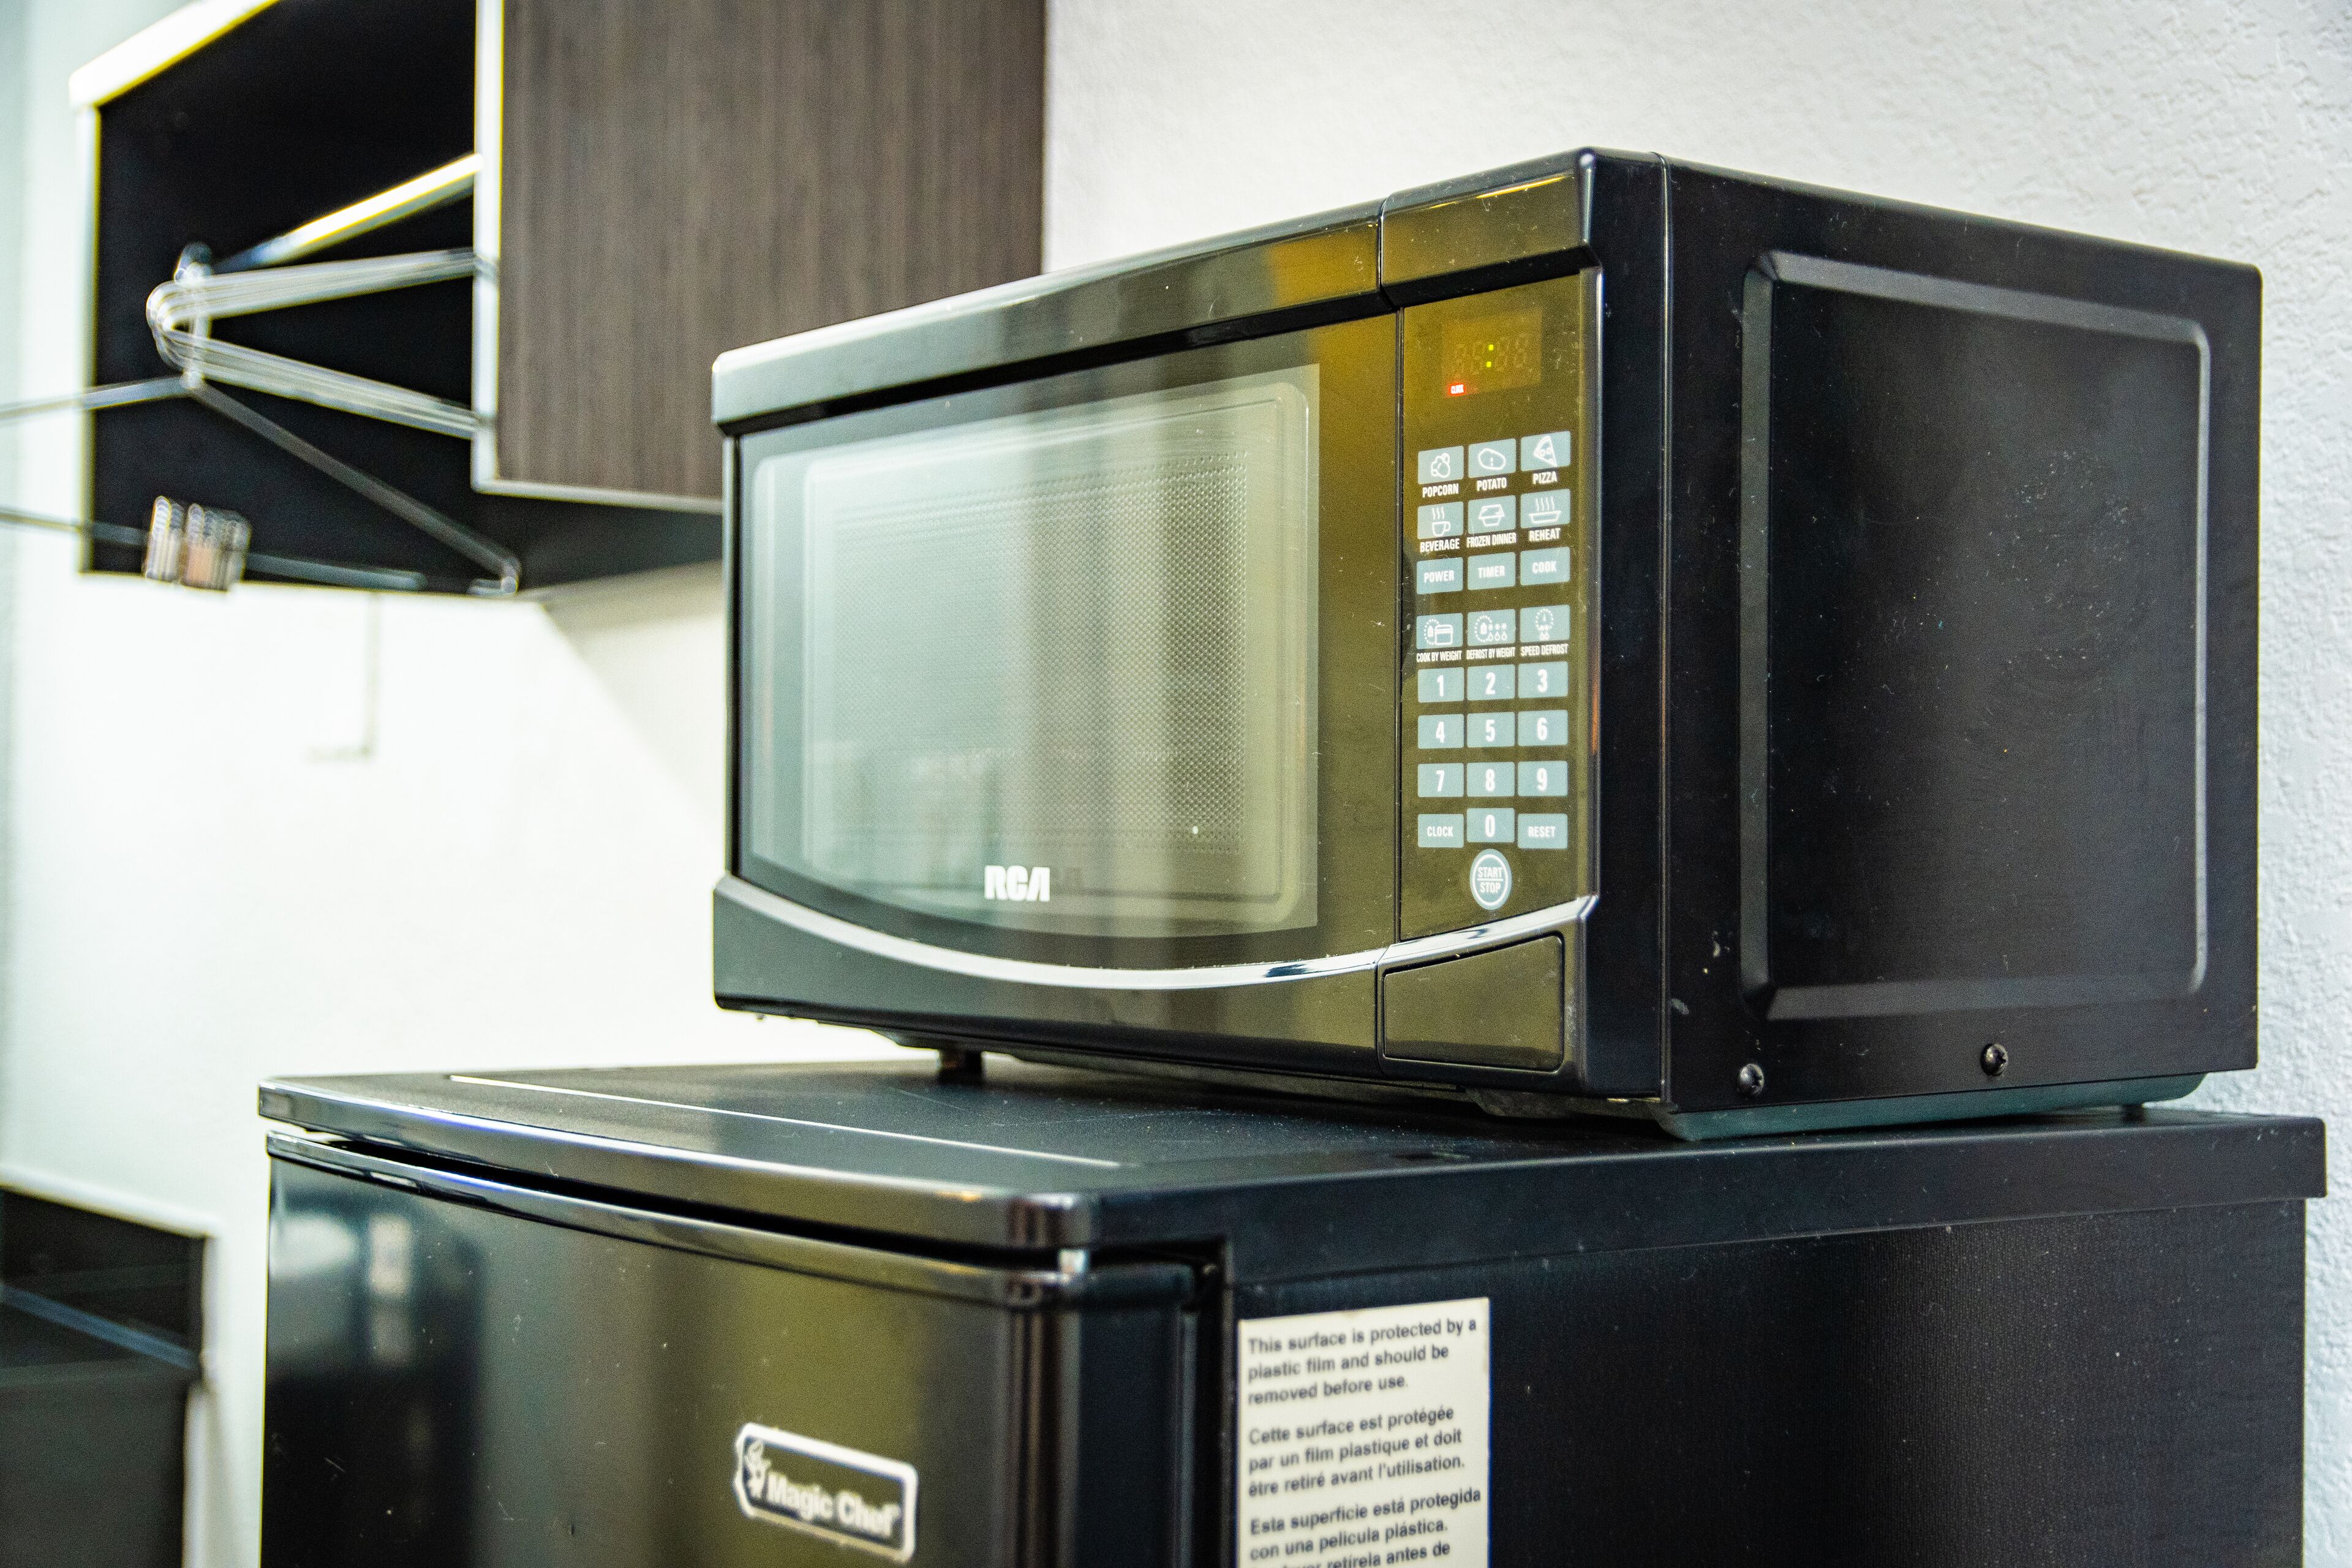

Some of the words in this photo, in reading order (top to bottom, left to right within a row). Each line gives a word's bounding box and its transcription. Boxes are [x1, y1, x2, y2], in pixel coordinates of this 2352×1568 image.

[1477, 477, 1507, 491] POTATO
[1532, 471, 1558, 484] PIZZA
[1422, 483, 1459, 498] POPCORN
[1420, 538, 1460, 552] BEVERAGE
[1466, 534, 1490, 548] FROZEN
[1491, 532, 1517, 546] DINNER
[1529, 527, 1561, 542] REHEAT
[1423, 570, 1455, 583] POWER
[1477, 565, 1506, 579] TIMER
[1532, 560, 1557, 574] COOK
[1417, 652, 1431, 663] COOK
[1431, 652, 1439, 662] BY
[1439, 650, 1462, 661] WEIGHT
[1466, 649, 1488, 660] DEFROST
[1488, 649, 1495, 658] BY
[1496, 647, 1515, 658] WEIGHT
[1520, 645, 1540, 657] SPEED
[1541, 644, 1568, 655] DEFROST
[1436, 674, 1444, 696] 1
[1485, 672, 1496, 695] 2
[1537, 669, 1548, 693] 3
[1436, 721, 1445, 743] 4
[1485, 719, 1495, 742] 5
[1537, 717, 1548, 741] 6
[1436, 770, 1445, 792] 7
[1485, 769, 1495, 791] 8
[1537, 767, 1548, 792] 9
[1427, 826, 1453, 837] CLOCK
[1485, 814, 1495, 838] 0
[1528, 826, 1556, 838] RESET
[984, 865, 1050, 902] RCA
[1477, 867, 1502, 878] START
[1480, 881, 1501, 893] STOP
[1248, 1336, 1282, 1354] This
[1288, 1332, 1346, 1349] surface
[1352, 1329, 1364, 1343] is
[1371, 1318, 1441, 1345] protected
[1447, 1318, 1463, 1336] by
[1469, 1319, 1476, 1331] a
[1248, 1360, 1301, 1384] plastic
[1306, 1356, 1335, 1373] film
[1341, 1351, 1369, 1370] and
[1375, 1344, 1426, 1365] should
[1431, 1343, 1449, 1359] be
[1248, 1382, 1317, 1406] removed
[1324, 1378, 1372, 1396] before
[1379, 1376, 1408, 1390] use.
[1250, 1427, 1290, 1445] Cette
[1296, 1420, 1354, 1439] surface
[1360, 1414, 1382, 1430] est
[1388, 1406, 1453, 1431] protégée
[1249, 1457, 1273, 1475] par
[1280, 1453, 1299, 1466] un
[1305, 1447, 1333, 1463] film
[1340, 1439, 1409, 1463] plastique
[1415, 1433, 1428, 1448] et
[1434, 1428, 1461, 1446] doit
[1284, 1471, 1325, 1491] retiré
[1331, 1466, 1373, 1486] avant
[1379, 1455, 1464, 1478] l'utilisation.
[767, 1471, 833, 1521] Magic
[838, 1491, 897, 1538] Chef
[1251, 1517, 1284, 1535] Esta
[1291, 1504, 1368, 1529] superficie
[1373, 1497, 1404, 1515] está
[1411, 1487, 1480, 1515] protegida
[1250, 1545, 1279, 1561] con
[1286, 1539, 1313, 1555] una
[1387, 1547, 1427, 1564] antes
[1433, 1540, 1450, 1556] de
